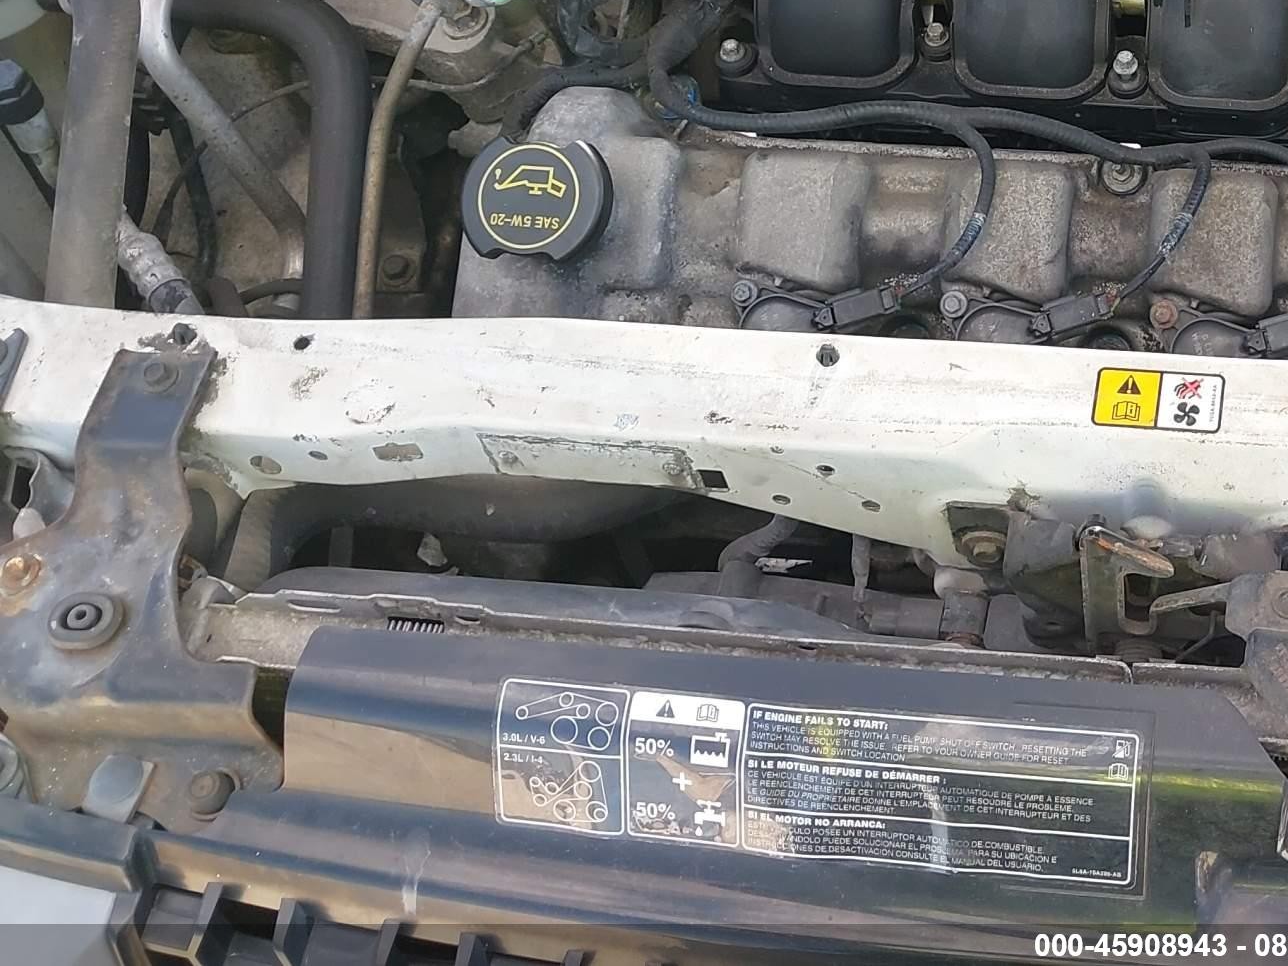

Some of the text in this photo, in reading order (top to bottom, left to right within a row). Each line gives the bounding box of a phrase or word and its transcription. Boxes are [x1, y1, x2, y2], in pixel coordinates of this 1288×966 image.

[489, 213, 560, 229] SAE 5W-20
[753, 710, 888, 730] IF ENGINE FAILS TO START:
[502, 732, 523, 743] 3.0L
[530, 734, 546, 745] V-6
[635, 737, 674, 757] 50%
[751, 731, 781, 742] SWITCH
[783, 734, 800, 743] MAY
[803, 735, 840, 747] RESOLVE
[891, 742, 919, 753] REFER
[921, 745, 932, 754] TO
[935, 746, 958, 756] YOUR
[1021, 753, 1039, 763] FOR
[1040, 755, 1069, 766] RESET
[752, 721, 769, 731] THIS
[771, 723, 804, 734] VEHICLE
[807, 726, 816, 735] IS
[817, 727, 859, 739] EQUIPPED
[862, 731, 881, 740] WITH
[940, 737, 965, 747] SHUT
[1021, 744, 1068, 756] RESETTING
[1070, 748, 1087, 757] THE
[503, 752, 524, 763] 2.3L
[531, 754, 543, 764] I-4
[750, 740, 862, 758] INSTRUCTIONS AND SWITCH
[747, 758, 757, 768] SI
[760, 759, 774, 770] LE
[776, 760, 819, 774] MOTEUR
[822, 764, 862, 777] REFUSE
[864, 768, 879, 779] DE
[882, 768, 940, 784] DÉMARRER
[747, 769, 758, 778] CE
[803, 774, 818, 783] EST
[876, 780, 937, 793] INTERRUPTEUR
[939, 785, 999, 799] AUTOMATIQUE
[1001, 790, 1012, 800] DE
[1014, 792, 1044, 803] POMPE
[747, 777, 1024, 809] LE DE CET INTERRUPTEUR PEUT LE
[636, 801, 676, 820] 50%
[747, 794, 795, 807] DIRECTIVES
[797, 798, 808, 808] DE
[748, 785, 758, 795] LE
[759, 786, 785, 797] GUIDE
[787, 789, 799, 798] DU
[862, 795, 892, 806] DONNE
[963, 804, 974, 813] DE
[976, 805, 994, 815] CET
[995, 807, 1059, 821] INTERRUPTEUR
[1061, 812, 1072, 822] ET
[1073, 813, 1091, 823] DES
[748, 811, 886, 830] SI EL MOTOR NO ARRANCA:
[812, 827, 983, 848] POSEE UN INTERRUPTOR DE
[822, 836, 851, 847] PUEDE
[852, 837, 906, 850] SOLUCIONAR
[908, 842, 918, 850] EL
[990, 850, 1002, 859] SU
[814, 844, 828, 853] DE
[895, 849, 938, 861] CONSULTE
[938, 855, 949, 864] EL
[986, 859, 1002, 869] DEL
[1004, 860, 1044, 873] USUARIO.
